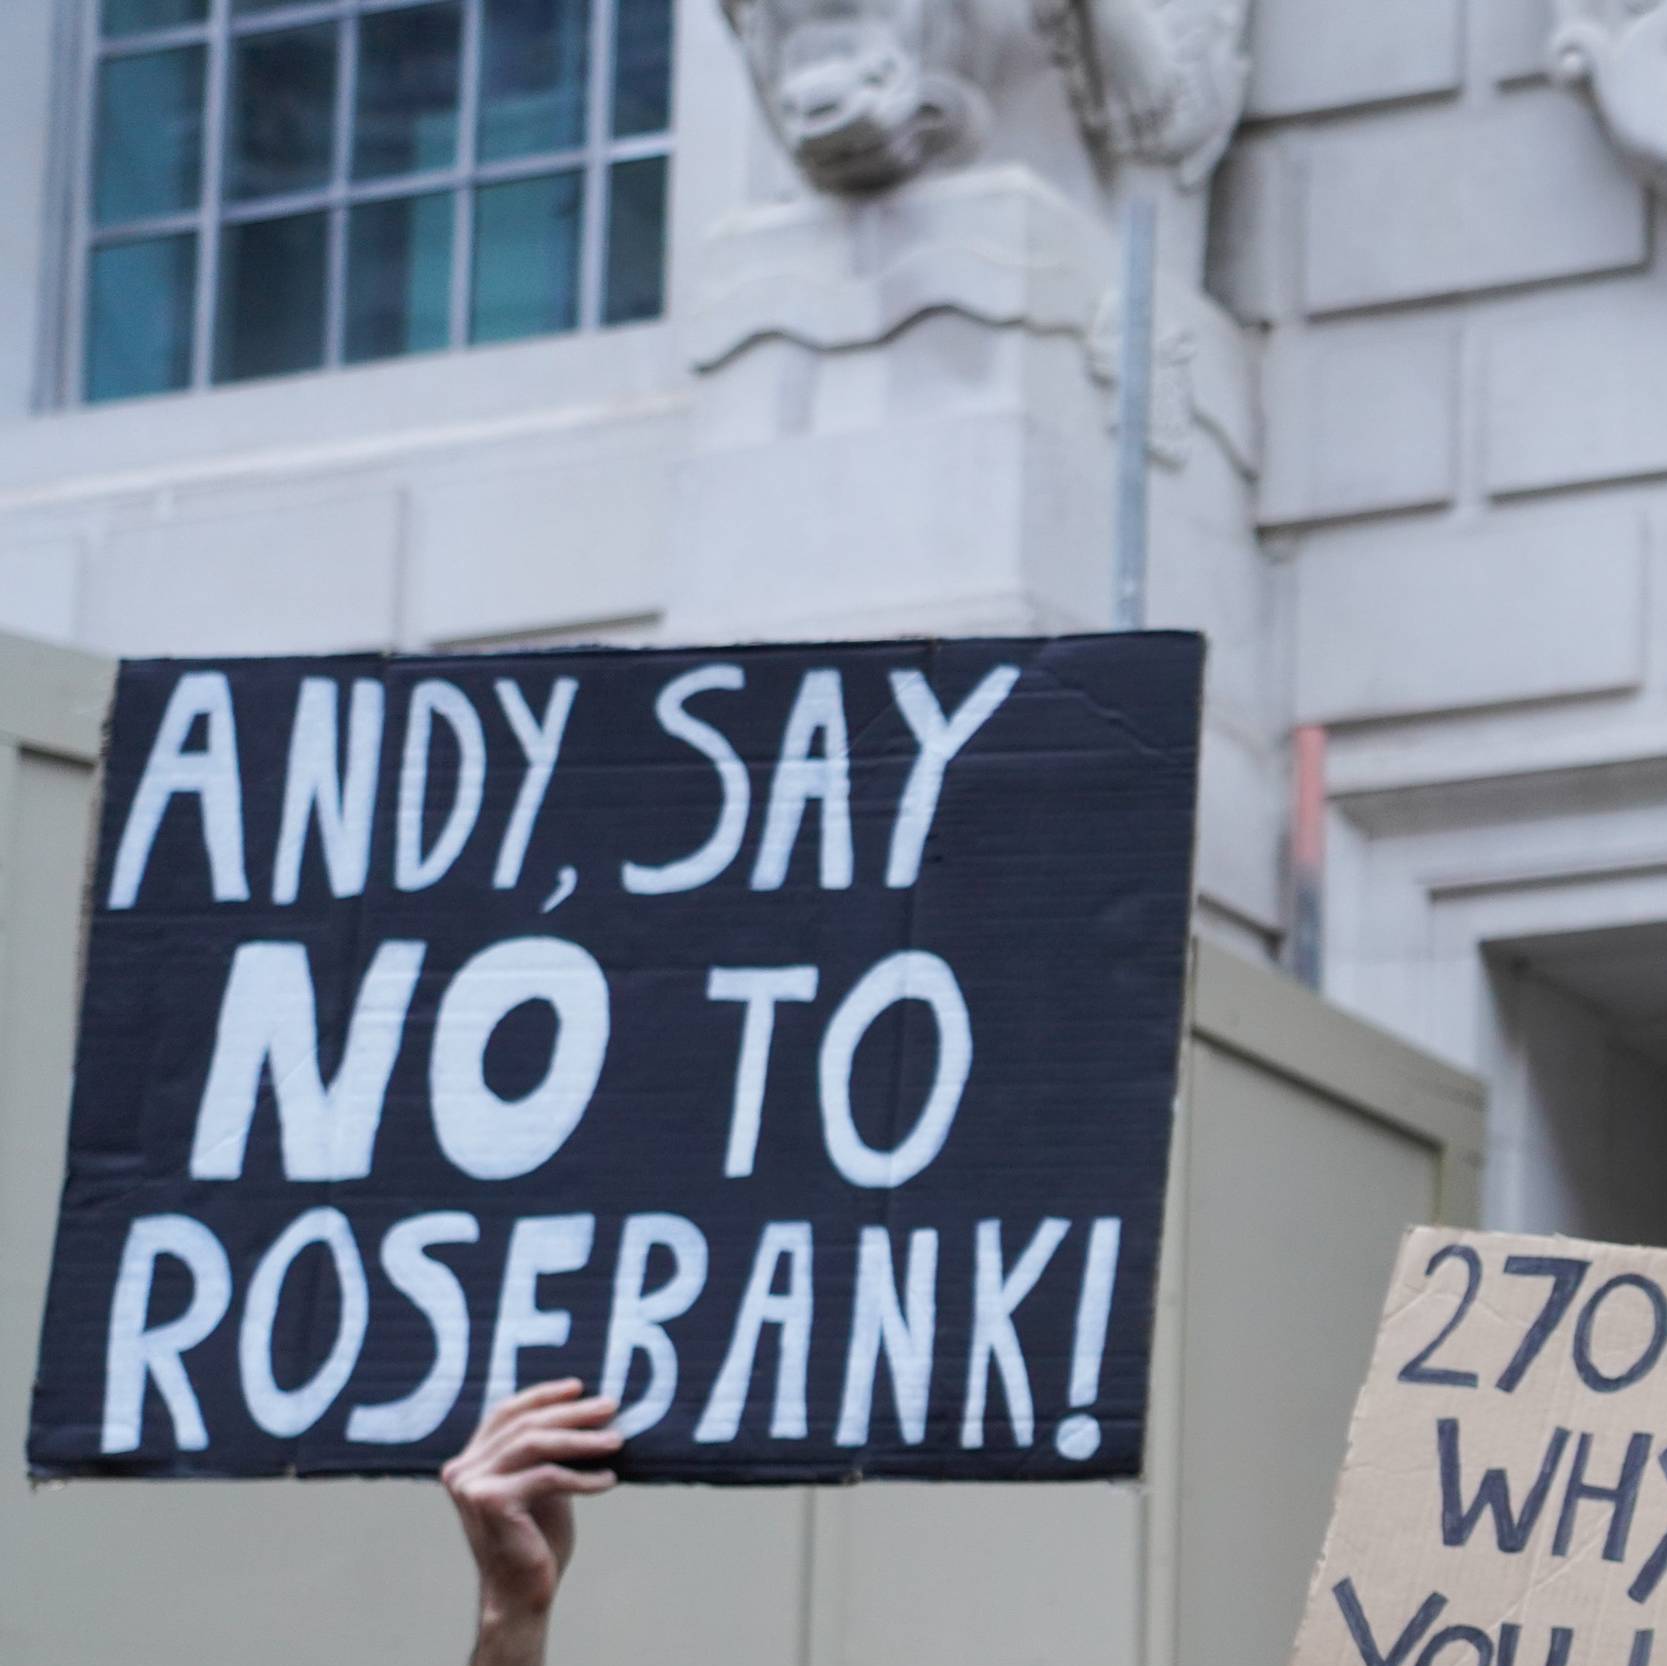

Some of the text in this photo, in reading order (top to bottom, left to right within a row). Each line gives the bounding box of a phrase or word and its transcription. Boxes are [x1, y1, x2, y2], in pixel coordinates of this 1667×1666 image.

[107, 665, 1019, 912] ANDY, SAY
[190, 936, 972, 1188] NO TO
[103, 1207, 1120, 1460] ROSEBANK!
